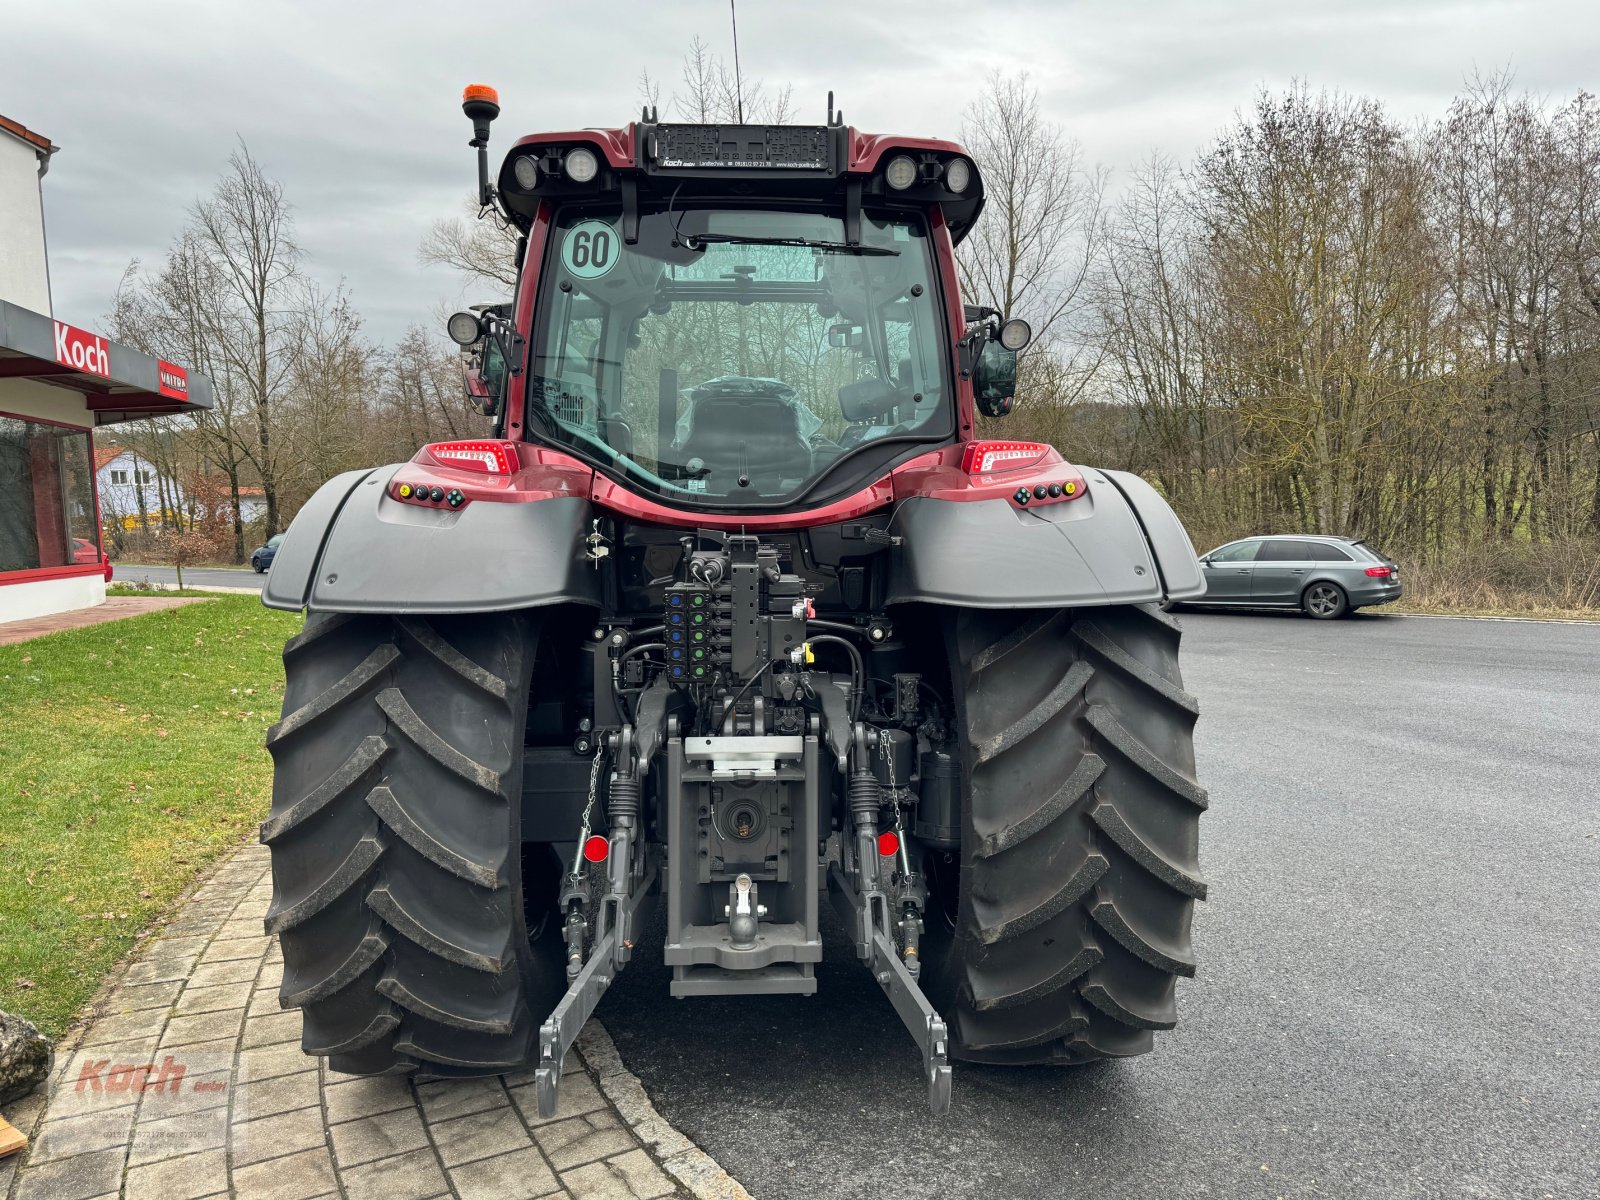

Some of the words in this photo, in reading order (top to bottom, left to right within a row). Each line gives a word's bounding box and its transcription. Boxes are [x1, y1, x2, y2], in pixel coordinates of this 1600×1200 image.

[663, 159, 683, 167] Koch
[572, 230, 609, 268] 60
[54, 320, 110, 376] Koch
[160, 370, 186, 388] VALTRA
